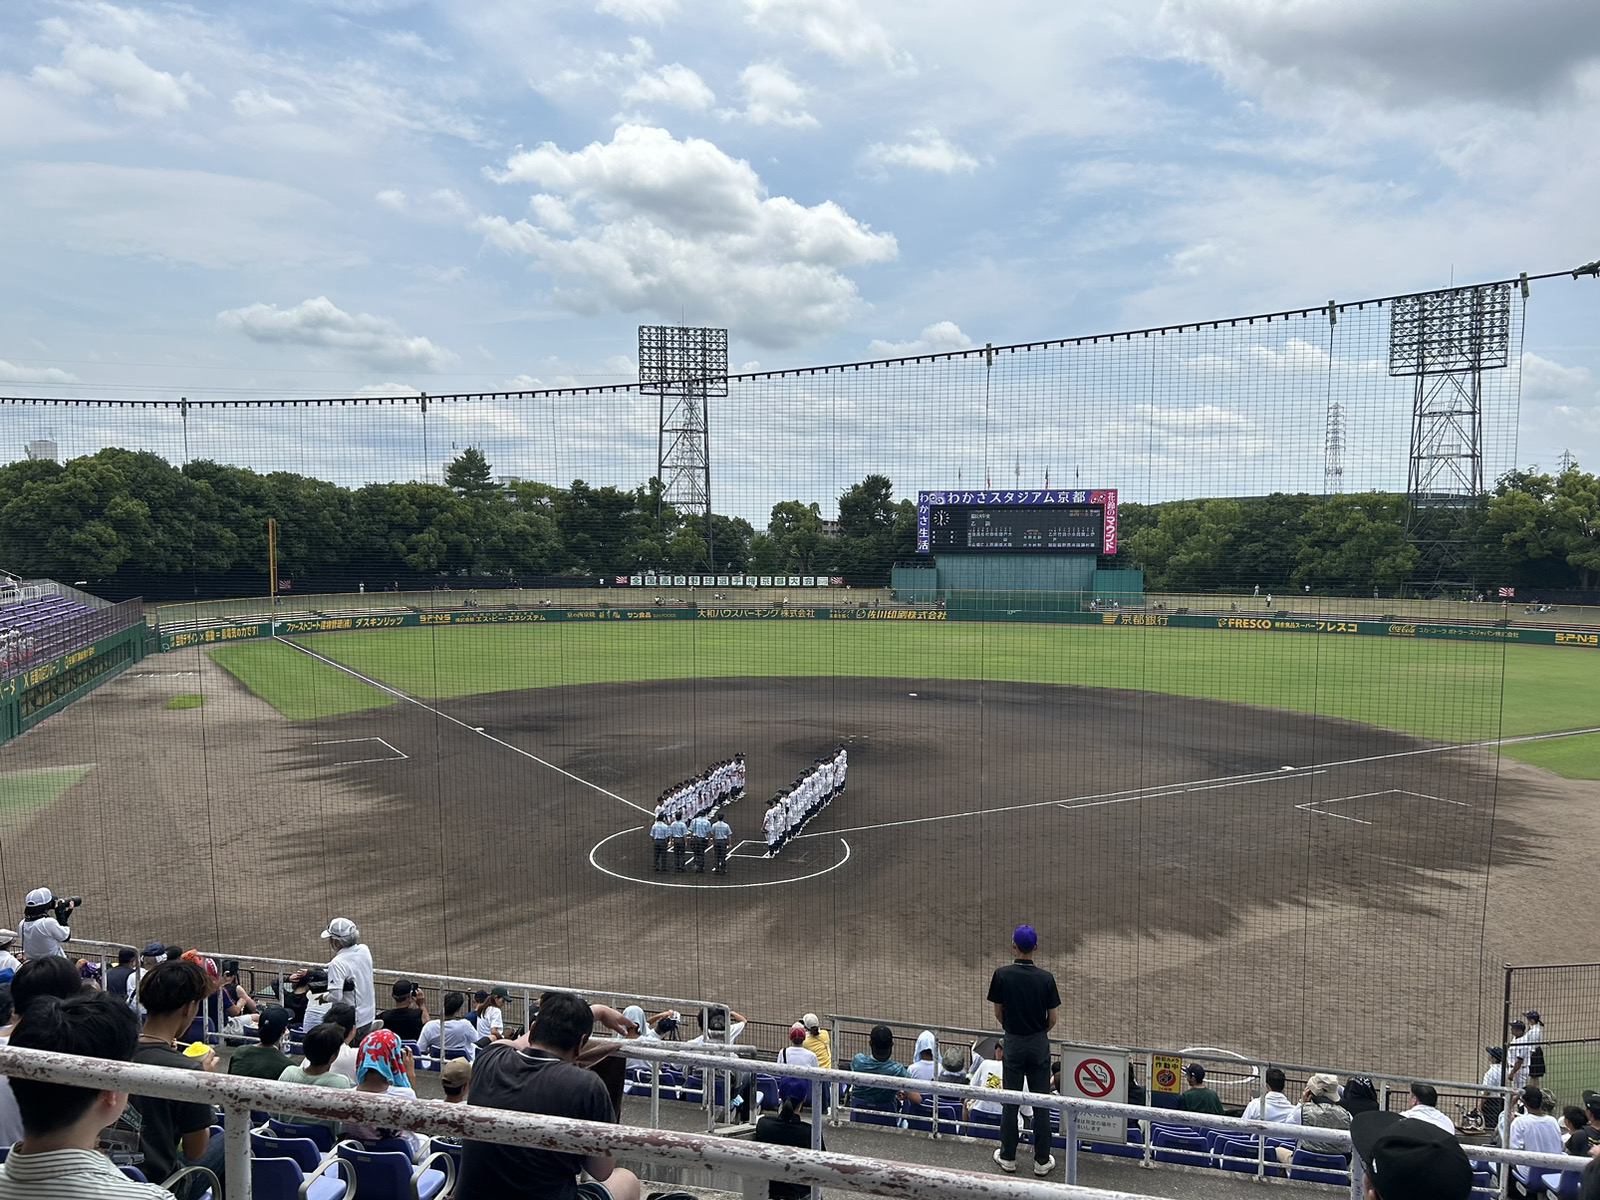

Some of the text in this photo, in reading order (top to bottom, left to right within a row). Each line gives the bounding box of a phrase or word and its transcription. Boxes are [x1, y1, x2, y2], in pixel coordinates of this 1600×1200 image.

[947, 491, 1086, 504] わかさスタジアム京都
[919, 494, 930, 551] わかさ生活
[867, 609, 947, 620] 佐川印刷株式会社
[1120, 614, 1169, 626] 京都銀行
[1228, 618, 1272, 629] FRESCO
[1316, 621, 1358, 633] フレスコ
[1155, 1062, 1179, 1070] 作動中
